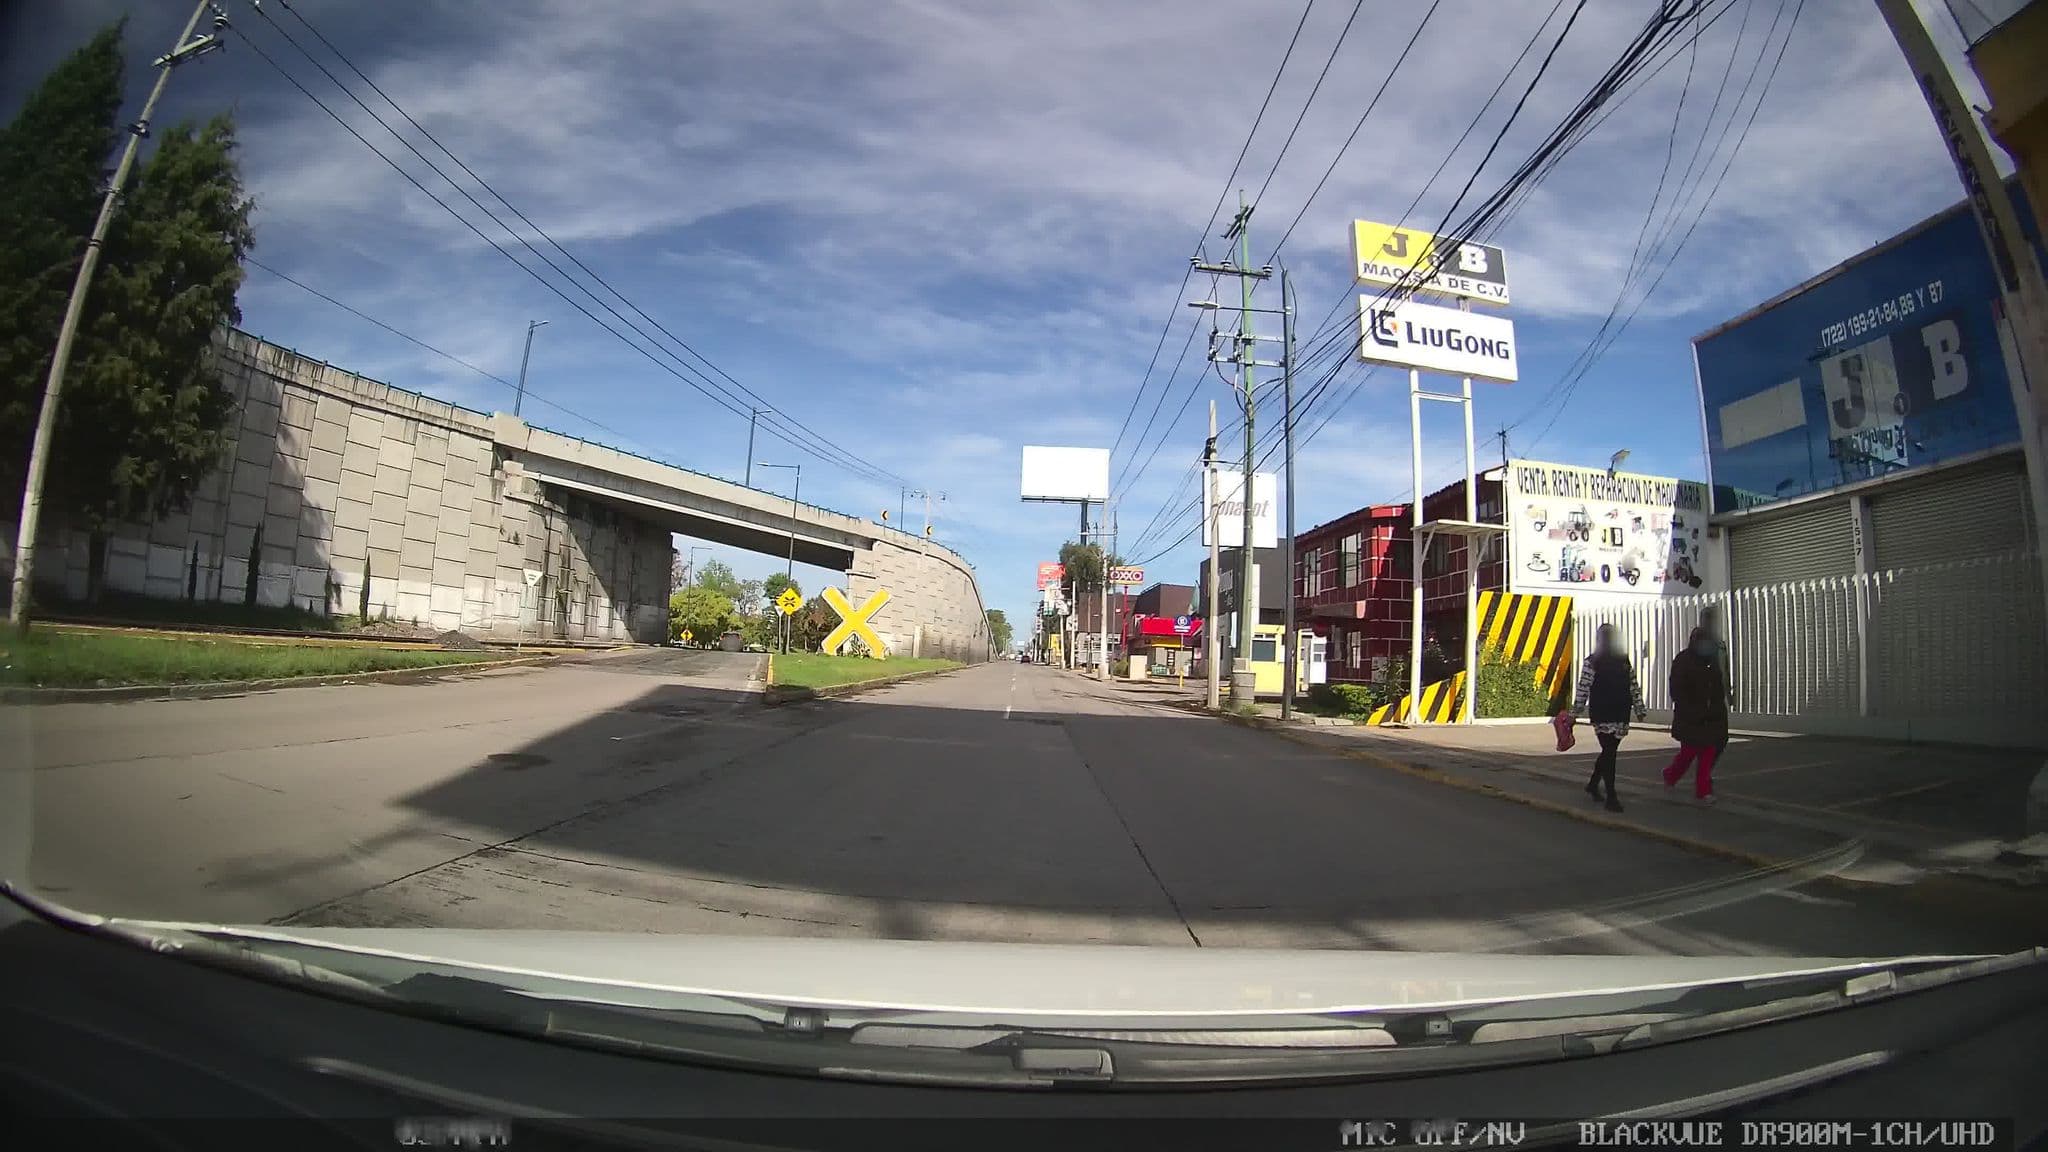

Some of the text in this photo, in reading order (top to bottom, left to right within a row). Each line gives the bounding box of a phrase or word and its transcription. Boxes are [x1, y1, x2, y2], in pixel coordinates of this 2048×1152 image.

[1448, 277, 1470, 292] DE
[1821, 320, 1847, 348] (722)
[1915, 287, 1925, 308] Y
[1928, 280, 1944, 304] 87
[1551, 469, 1581, 499] RENTA
[1581, 472, 1588, 500] Y
[1590, 473, 1642, 505] REPARACION
[1642, 479, 1654, 506] DE
[1110, 570, 1144, 580] OXXO
